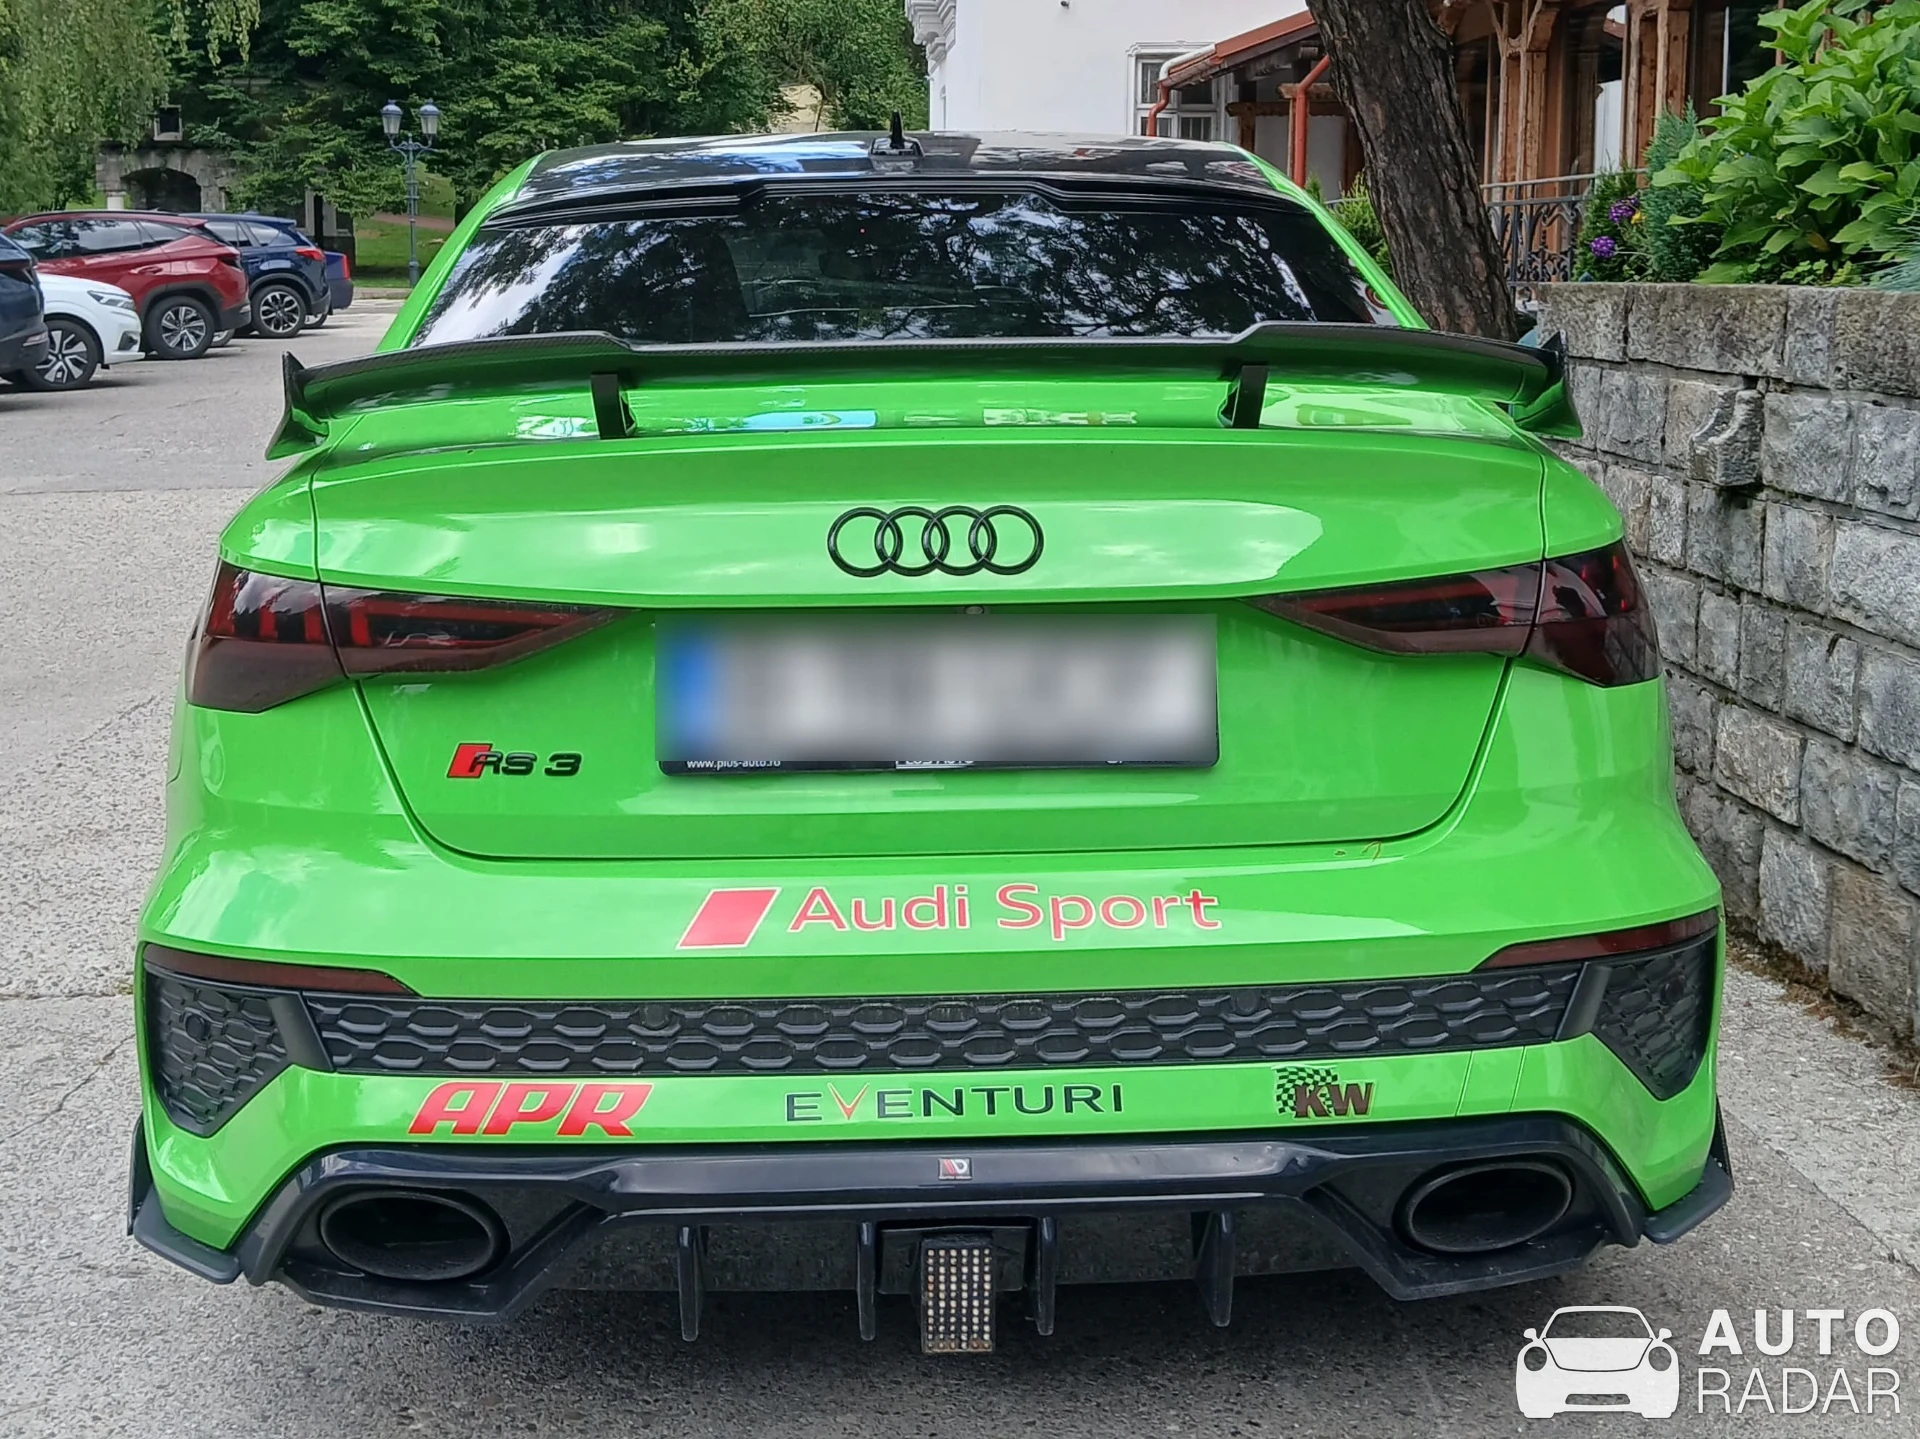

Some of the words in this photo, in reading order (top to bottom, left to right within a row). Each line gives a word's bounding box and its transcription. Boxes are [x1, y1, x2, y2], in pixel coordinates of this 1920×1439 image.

[468, 750, 538, 776] RS
[544, 752, 583, 777] 3
[787, 886, 972, 933] Audi
[995, 883, 1222, 942] Sport
[407, 1080, 654, 1137] APR
[785, 1082, 1124, 1122] EVENTURI
[1294, 1081, 1375, 1119] KW
